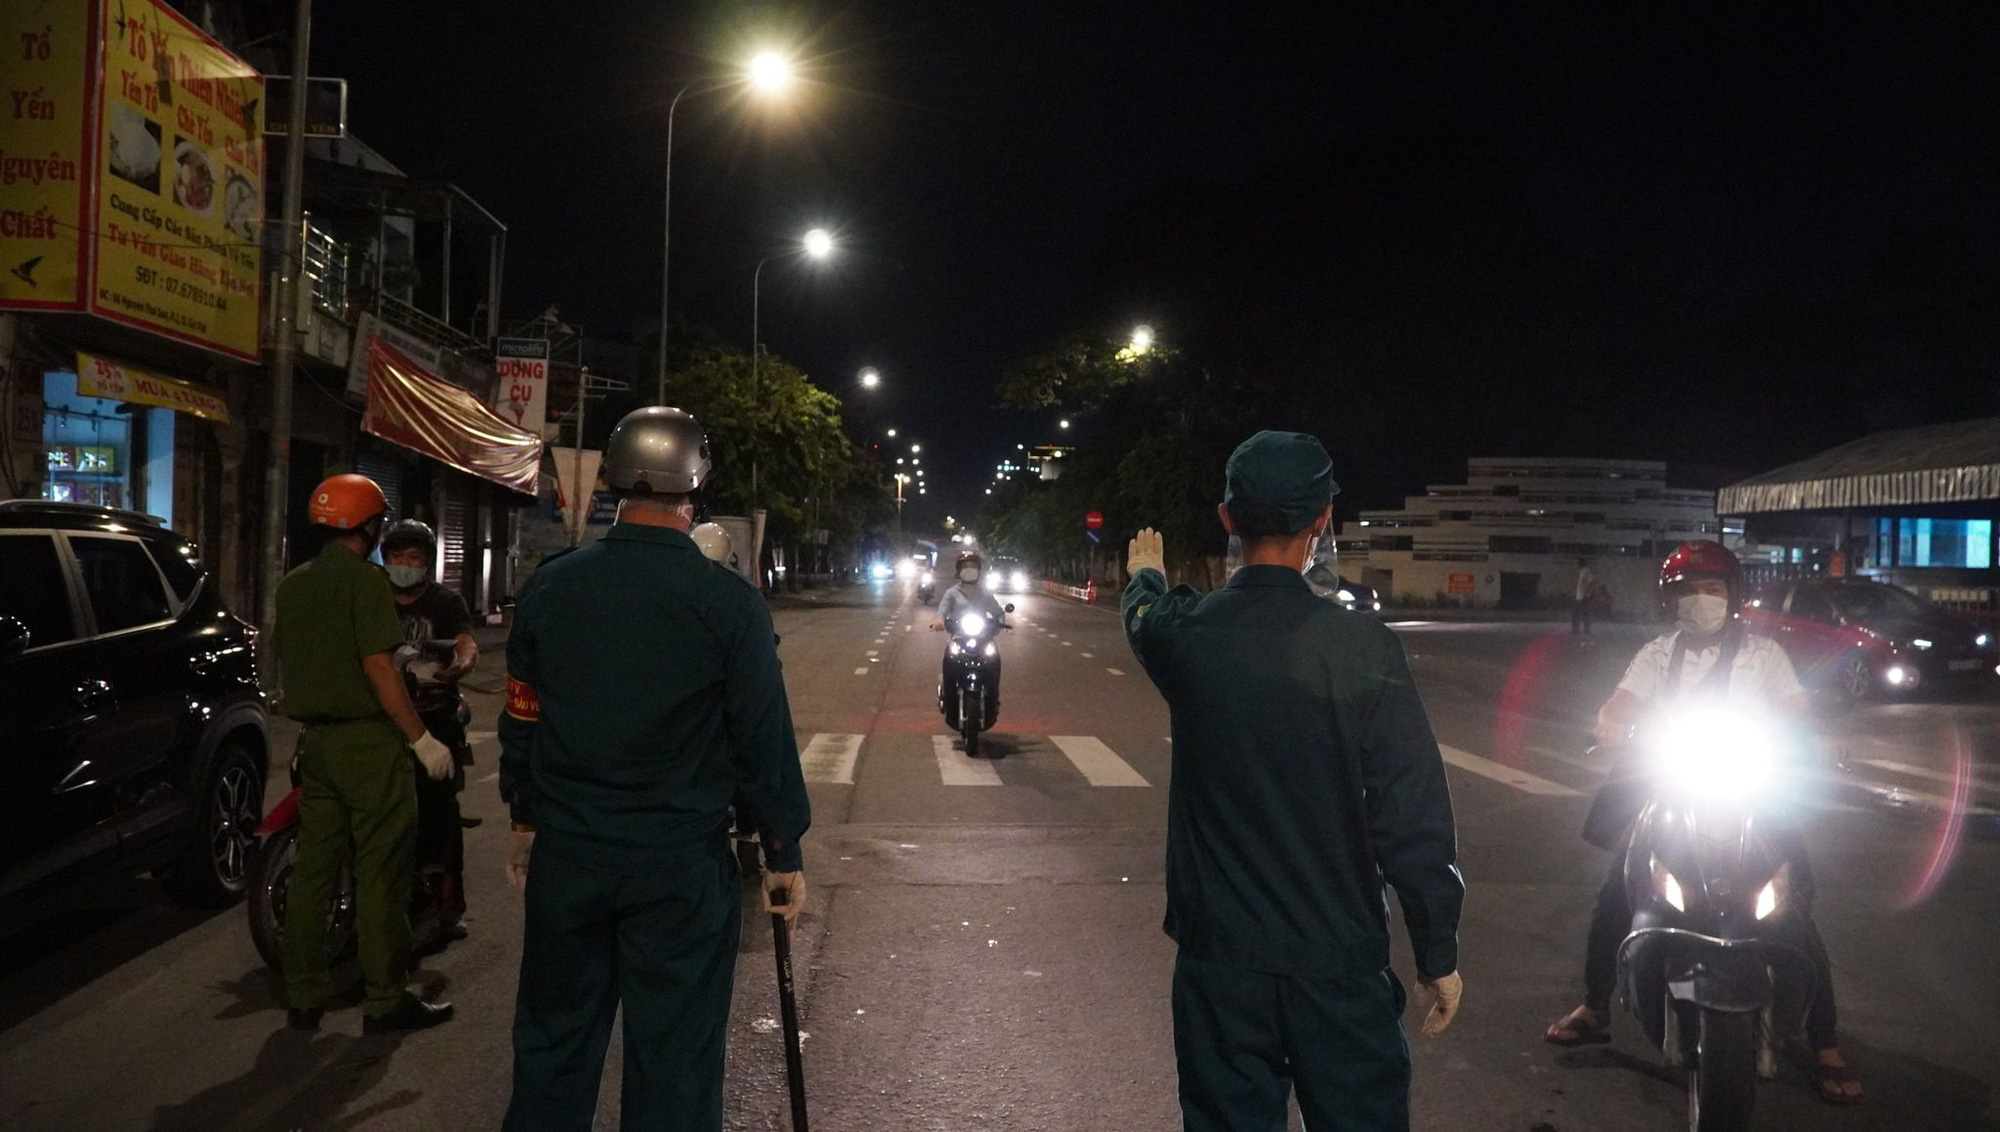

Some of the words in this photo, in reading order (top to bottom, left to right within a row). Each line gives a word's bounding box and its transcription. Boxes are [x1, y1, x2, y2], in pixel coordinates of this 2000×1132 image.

[20, 25, 52, 61] Tổ
[127, 13, 147, 62] Tổ
[11, 86, 56, 121] Yến
[0, 151, 76, 186] guyên
[0, 205, 58, 240] Chất
[110, 193, 140, 221] Cung
